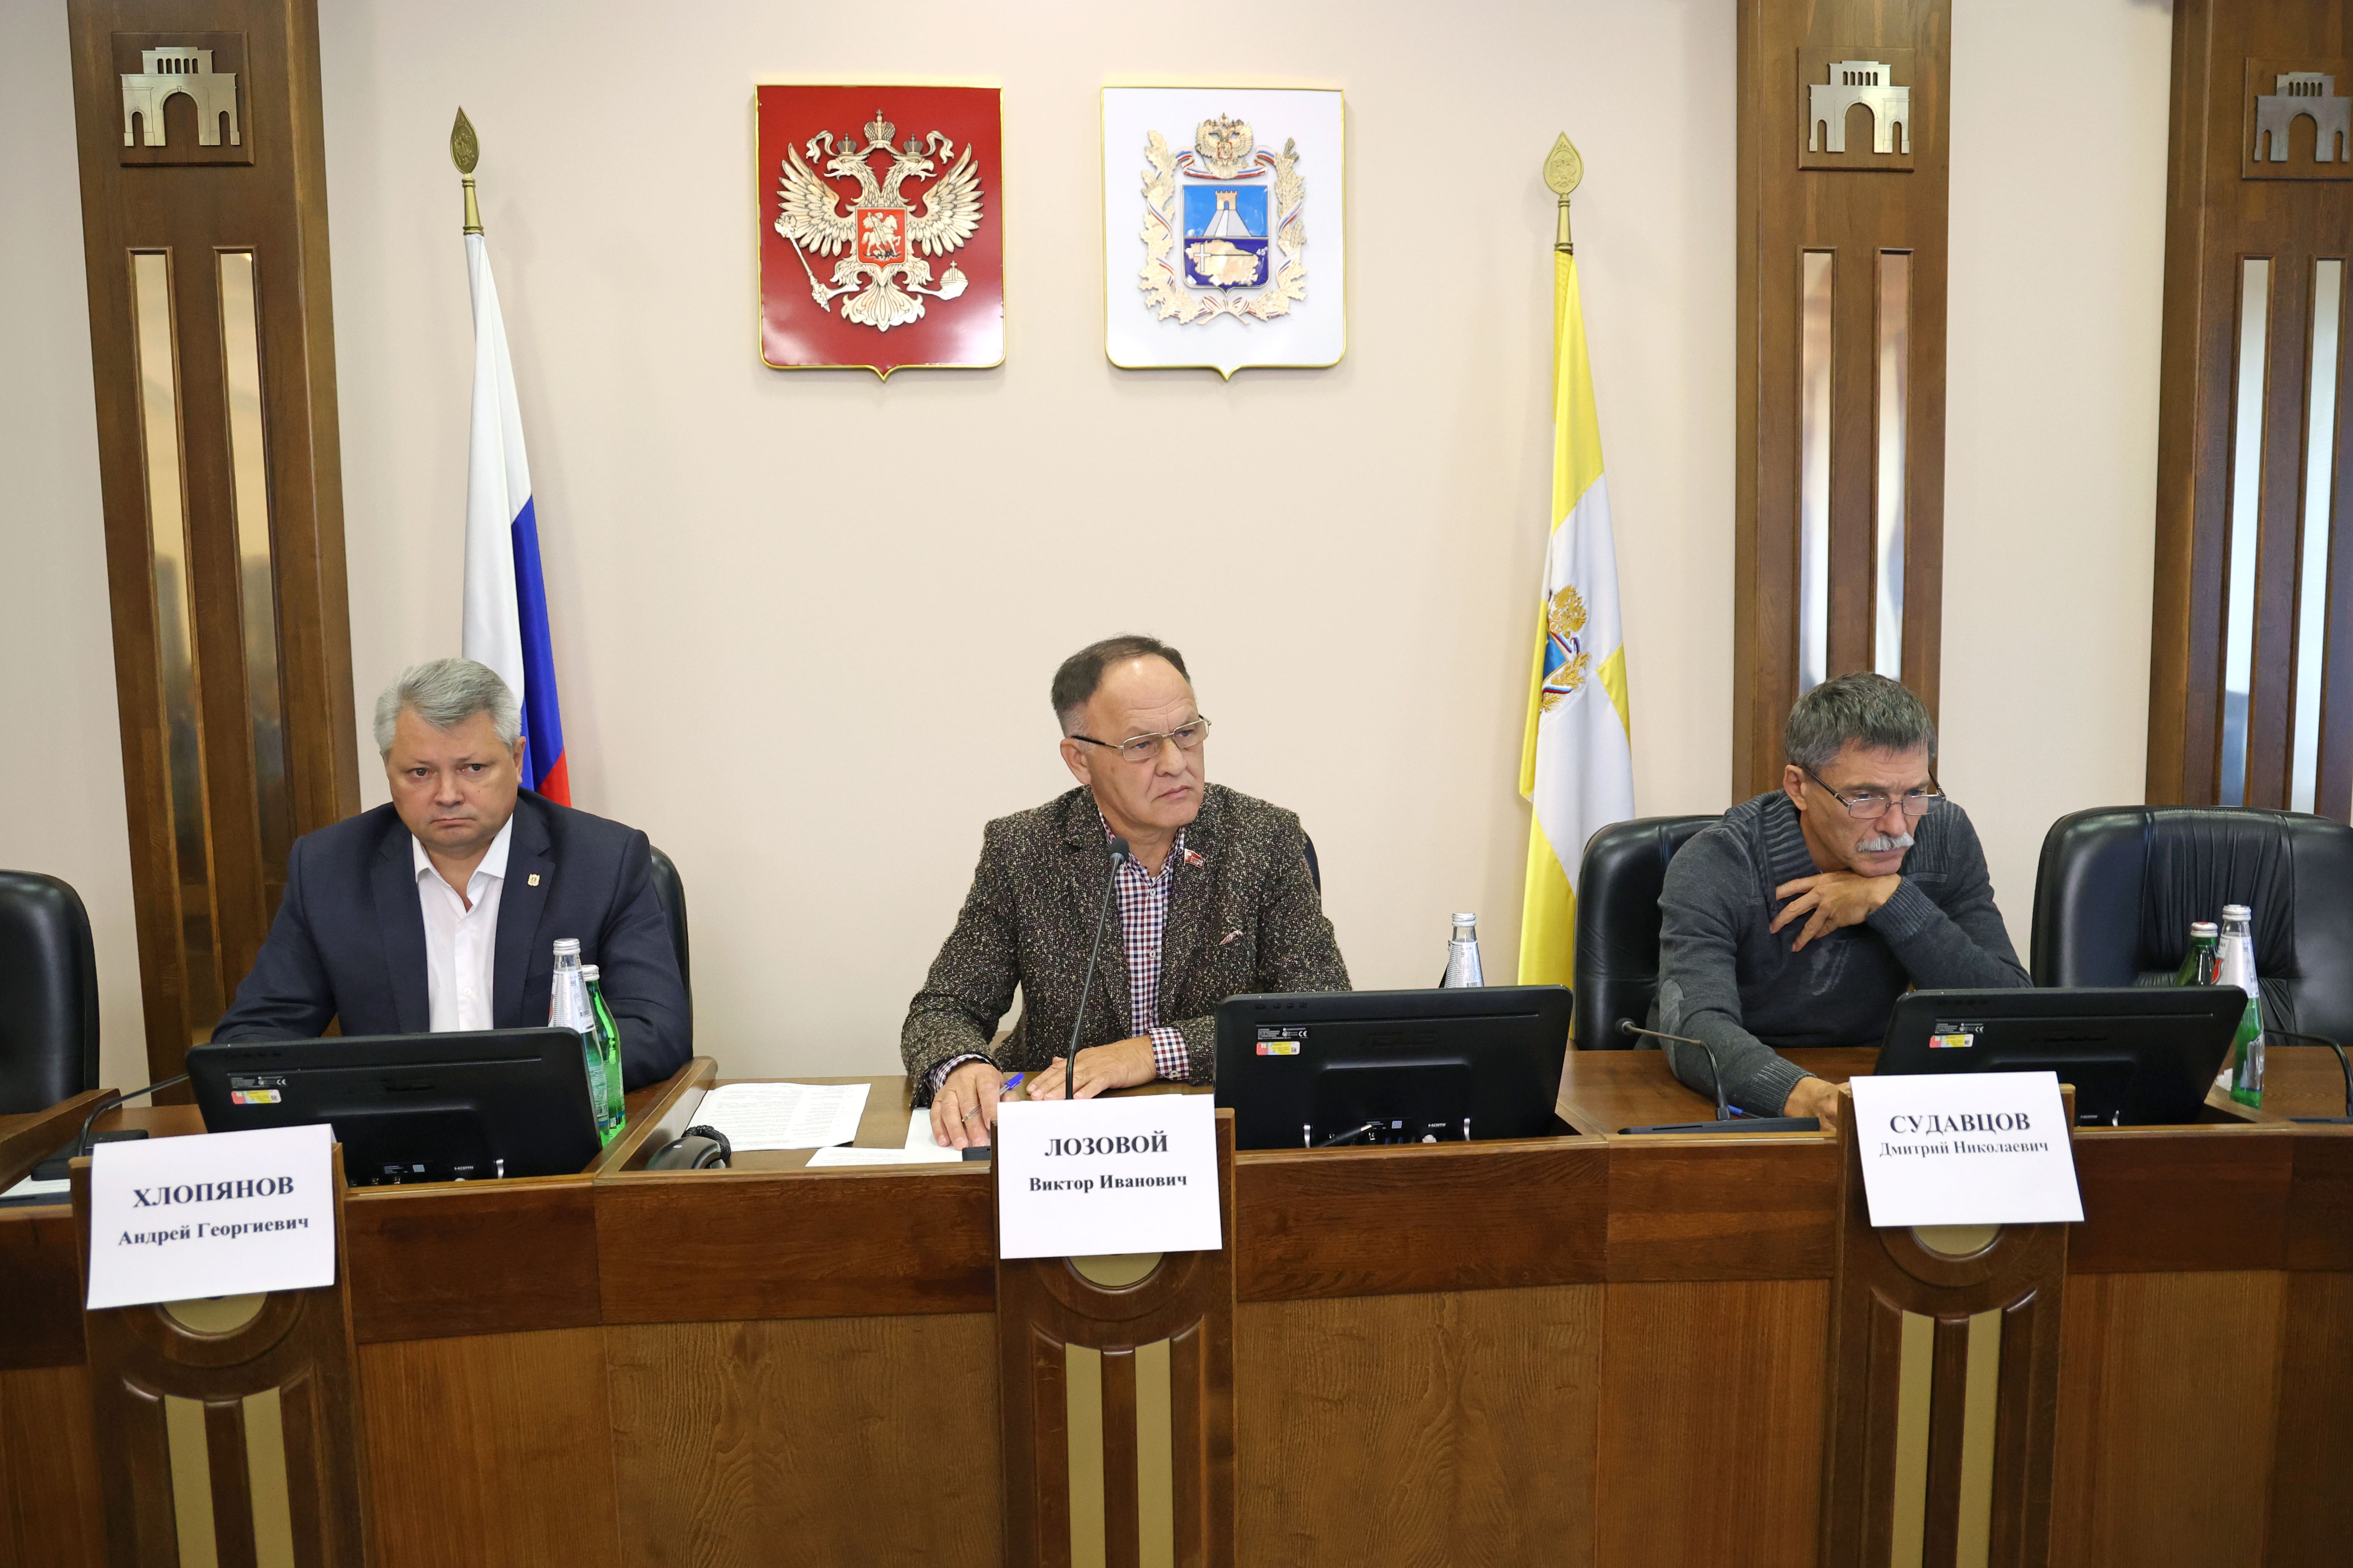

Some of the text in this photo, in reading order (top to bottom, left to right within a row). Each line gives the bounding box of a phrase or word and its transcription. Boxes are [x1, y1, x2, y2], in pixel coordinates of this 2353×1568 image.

[1890, 1112, 2031, 1136] СУДАВЦОВ
[1044, 1130, 1169, 1157] ЛОЗОВОЙ
[1879, 1141, 2049, 1158] Дмитрий Николаевич
[132, 1176, 295, 1208] ХЛОПЯНОВ
[1029, 1175, 1187, 1194] Виктор Иванович
[118, 1217, 309, 1246] Андрей Георгиевич
